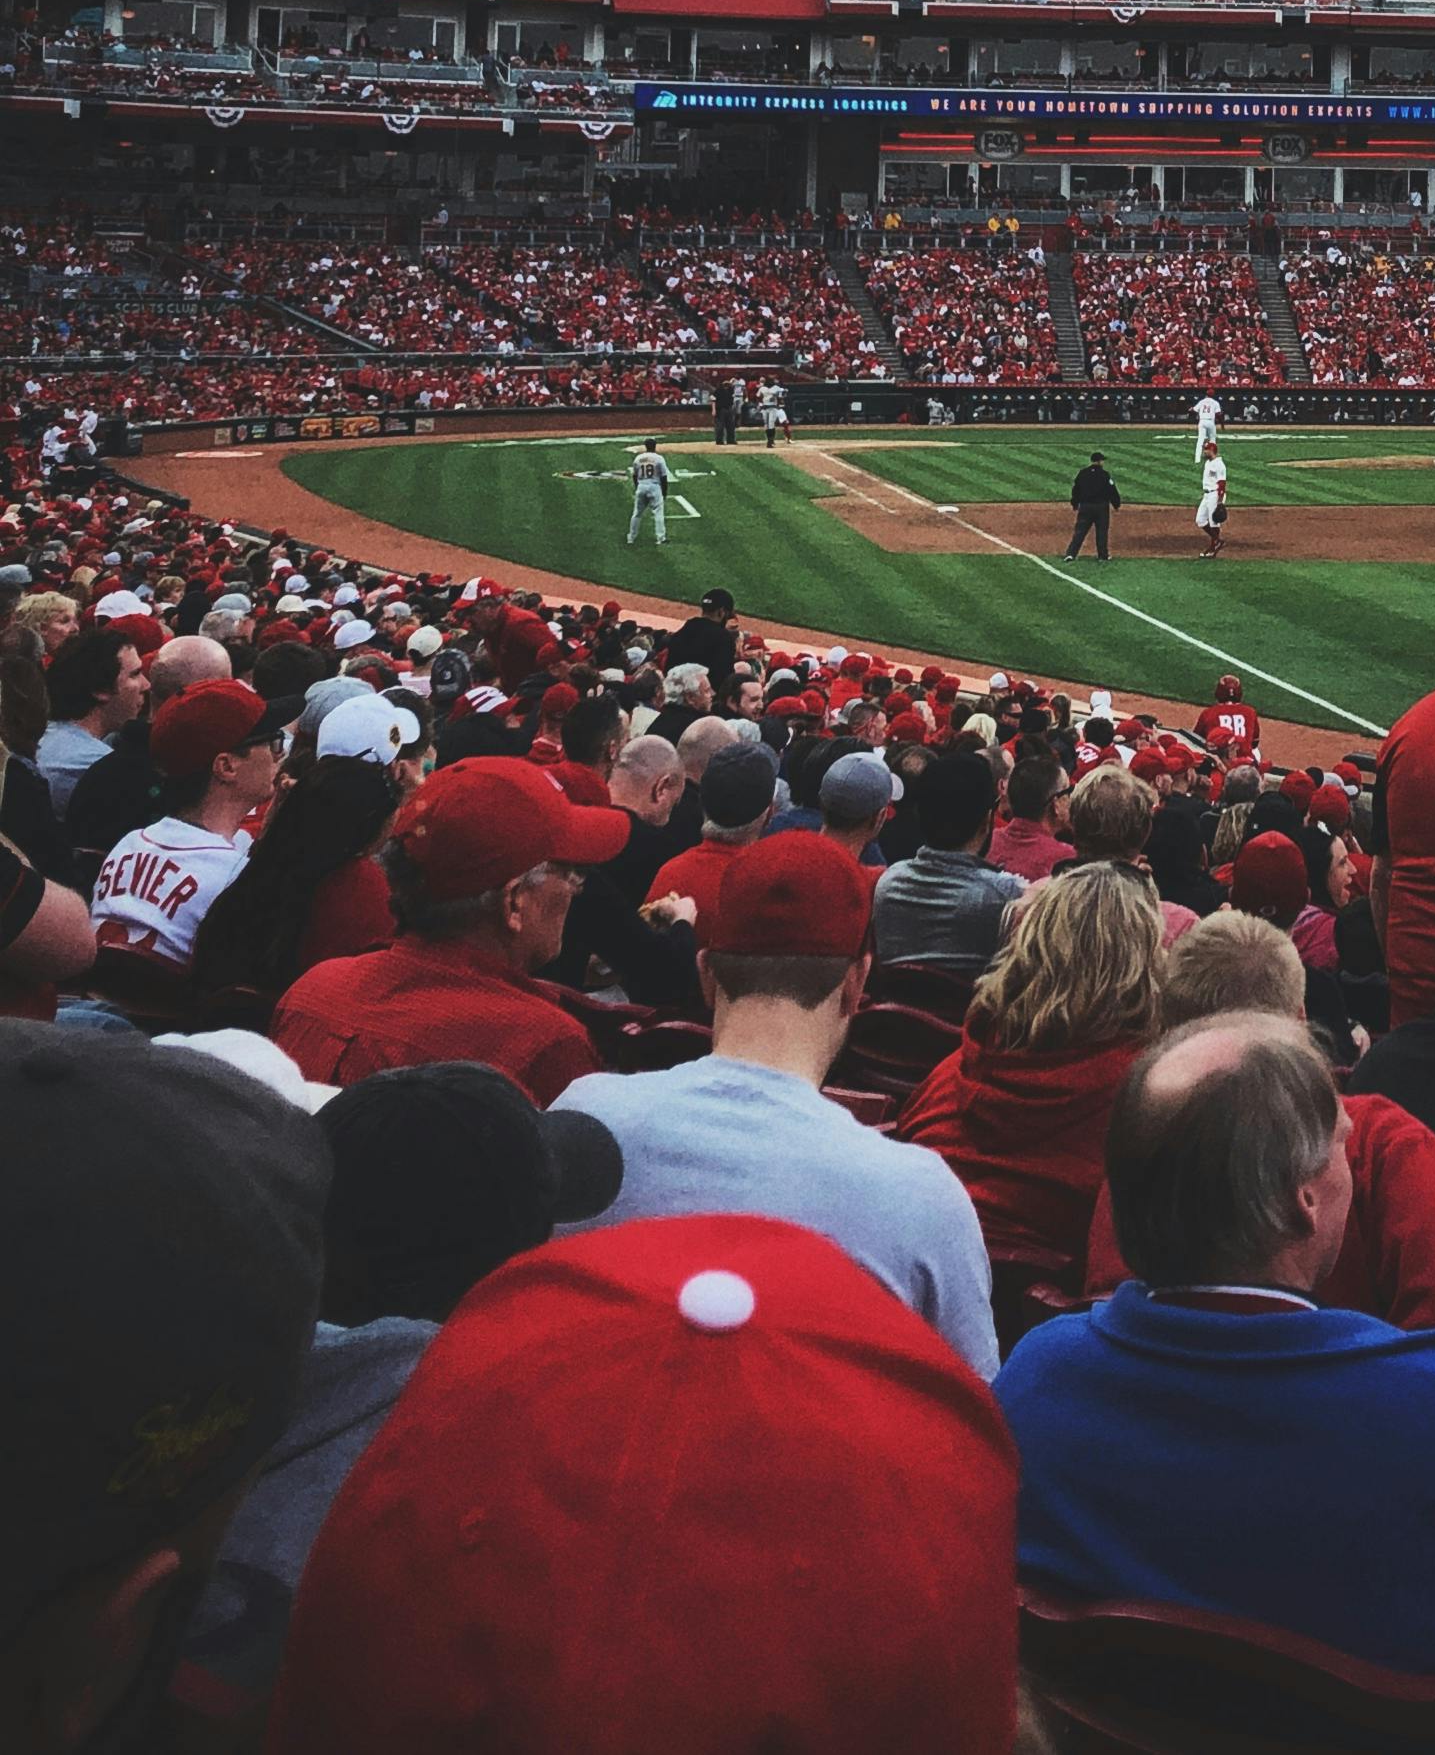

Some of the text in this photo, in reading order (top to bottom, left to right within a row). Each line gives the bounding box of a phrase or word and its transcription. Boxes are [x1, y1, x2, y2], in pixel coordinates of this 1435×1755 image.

[682, 94, 908, 111] INTEGRITY EXPRESS LOGISTICS
[931, 99, 1373, 117] WE ARE YOUR HOMETOWN SHIPPING SOLUTION EXPERTS
[983, 133, 1016, 147] FOX
[1273, 137, 1302, 150] FOX
[640, 463, 654, 477] 18
[97, 851, 199, 920] SEVIER
